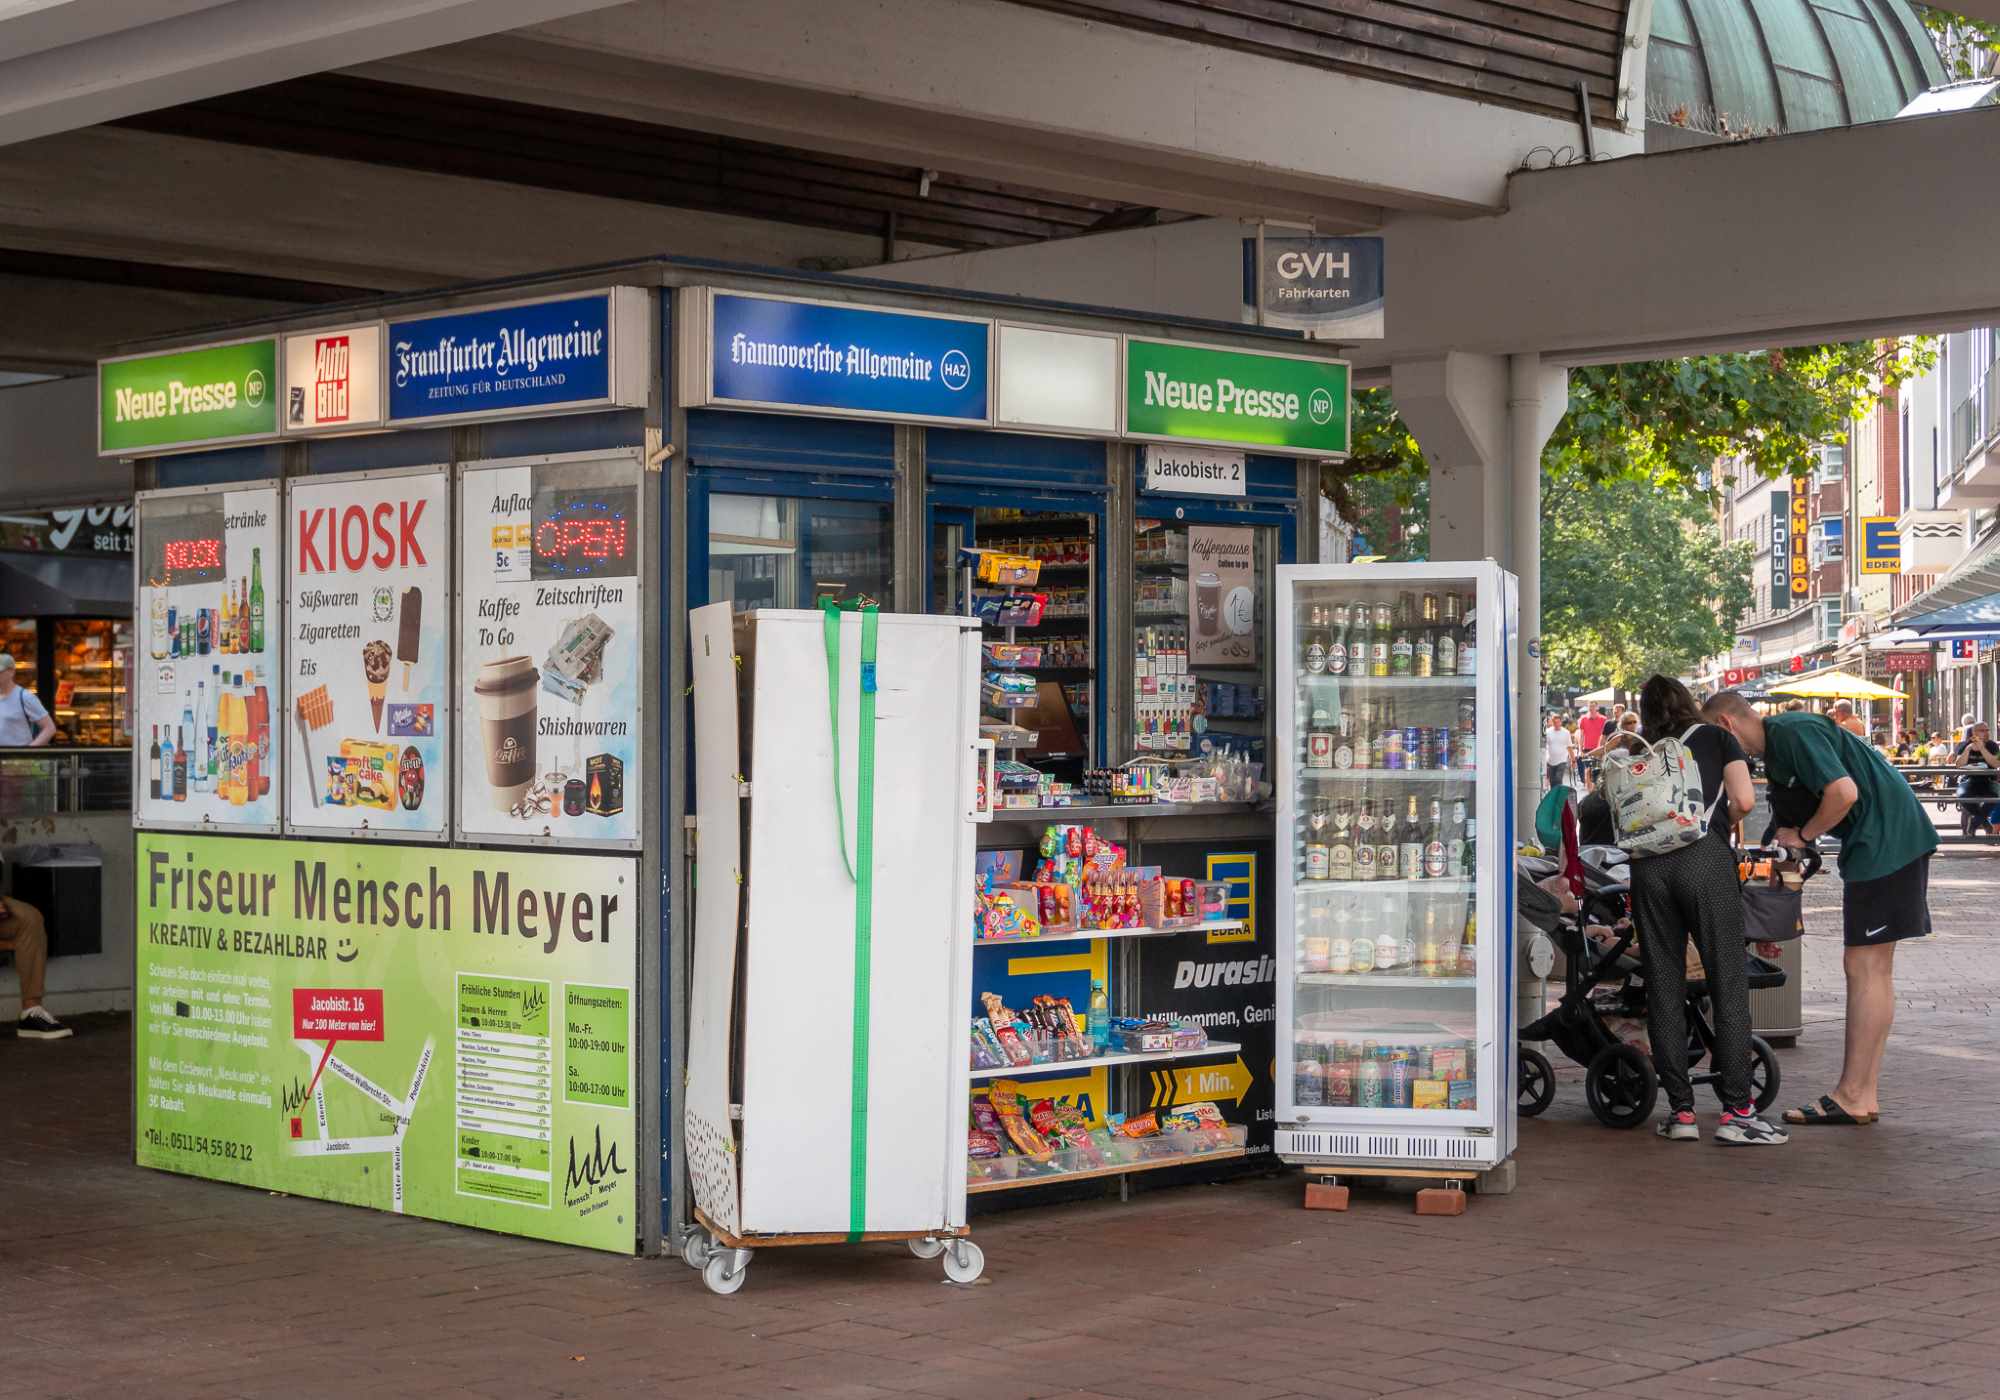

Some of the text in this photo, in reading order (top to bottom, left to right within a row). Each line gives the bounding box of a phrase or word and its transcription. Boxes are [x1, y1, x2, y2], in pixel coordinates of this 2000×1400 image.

[1277, 252, 1350, 279] GVH
[1278, 287, 1350, 298] Fahrkarten
[315, 341, 348, 381] Auto
[396, 320, 603, 388] Frankfurter Allgemeine
[731, 333, 933, 382] Hannoversche Allgemeine
[944, 363, 967, 378] HAZ
[248, 381, 263, 396] NP
[428, 374, 566, 400] ZEITUNG FÜR DEUTSCHLAND
[1144, 371, 1300, 420] Neue Presse
[115, 380, 237, 423] Neue Presse
[317, 381, 348, 420] Bild
[1312, 399, 1329, 413] NP
[1154, 459, 1240, 480] Jakobistr. 2
[94, 533, 122, 551] seit
[299, 499, 428, 573] KIOSK
[535, 520, 626, 558] OPEN
[1792, 477, 1808, 593] TCHIBO
[1774, 515, 1785, 586] DEPOT
[299, 590, 359, 613] Süßwaren
[536, 584, 623, 608] Zeitschriften
[478, 597, 520, 622] Kaffee
[299, 623, 361, 644] Zigaretten
[479, 627, 514, 646] To Go
[299, 658, 317, 676] Eis
[538, 716, 627, 737] Shishawaren
[149, 850, 618, 954] Friseur Mensch Meyer
[150, 922, 327, 960] KREATIV & BEZAHLBAR
[311, 996, 365, 1012] Jacobistr. 16
[568, 991, 622, 1010] Öffnungszeiten:
[568, 1022, 593, 1035] Mo.-Fr.
[568, 1037, 625, 1054] 10:00-19:00 Uhr
[568, 1065, 580, 1078] Sa.
[568, 1081, 625, 1098] 10:00-17:00 Uhr
[1184, 1072, 1235, 1095] 1 Min.
[149, 1127, 169, 1147] Tel.:
[211, 1140, 223, 1156] 55
[225, 1142, 237, 1159] 82
[240, 1143, 253, 1161] 12
